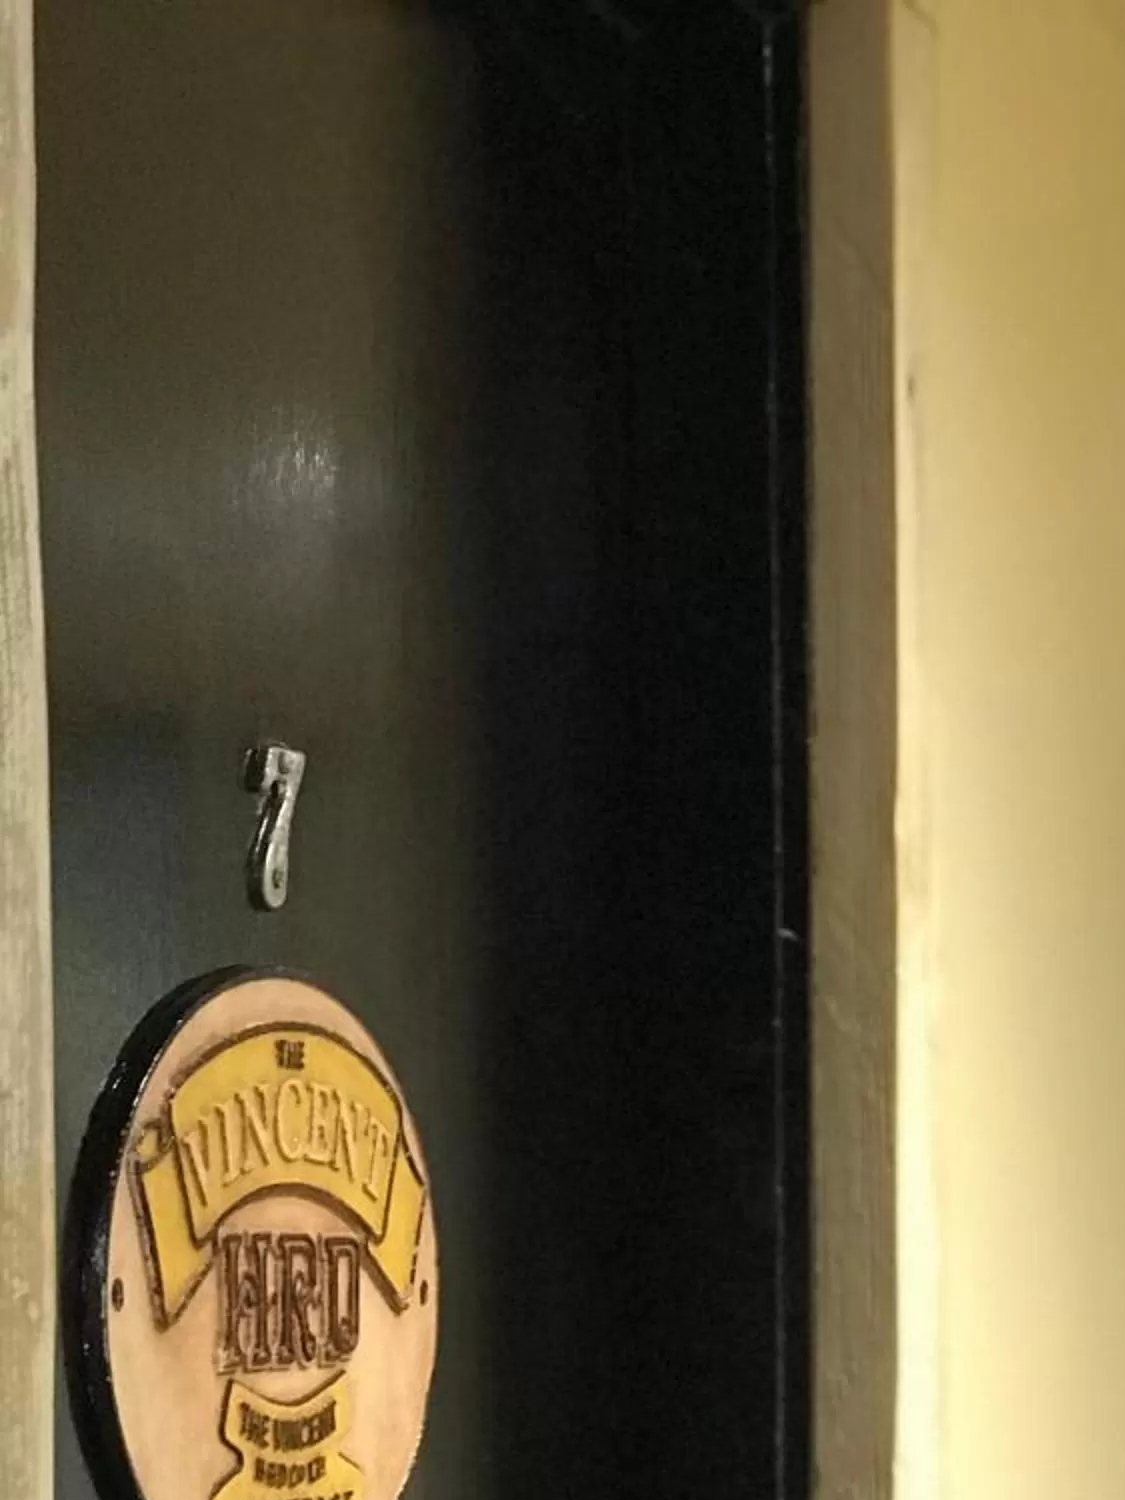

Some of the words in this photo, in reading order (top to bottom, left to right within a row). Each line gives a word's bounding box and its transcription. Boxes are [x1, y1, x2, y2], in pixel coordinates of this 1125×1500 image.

[244, 745, 307, 911] 7
[273, 1039, 305, 1071] THE
[180, 1078, 394, 1207] VINCENT
[217, 1231, 363, 1375] HRD
[239, 1401, 270, 1449] THE
